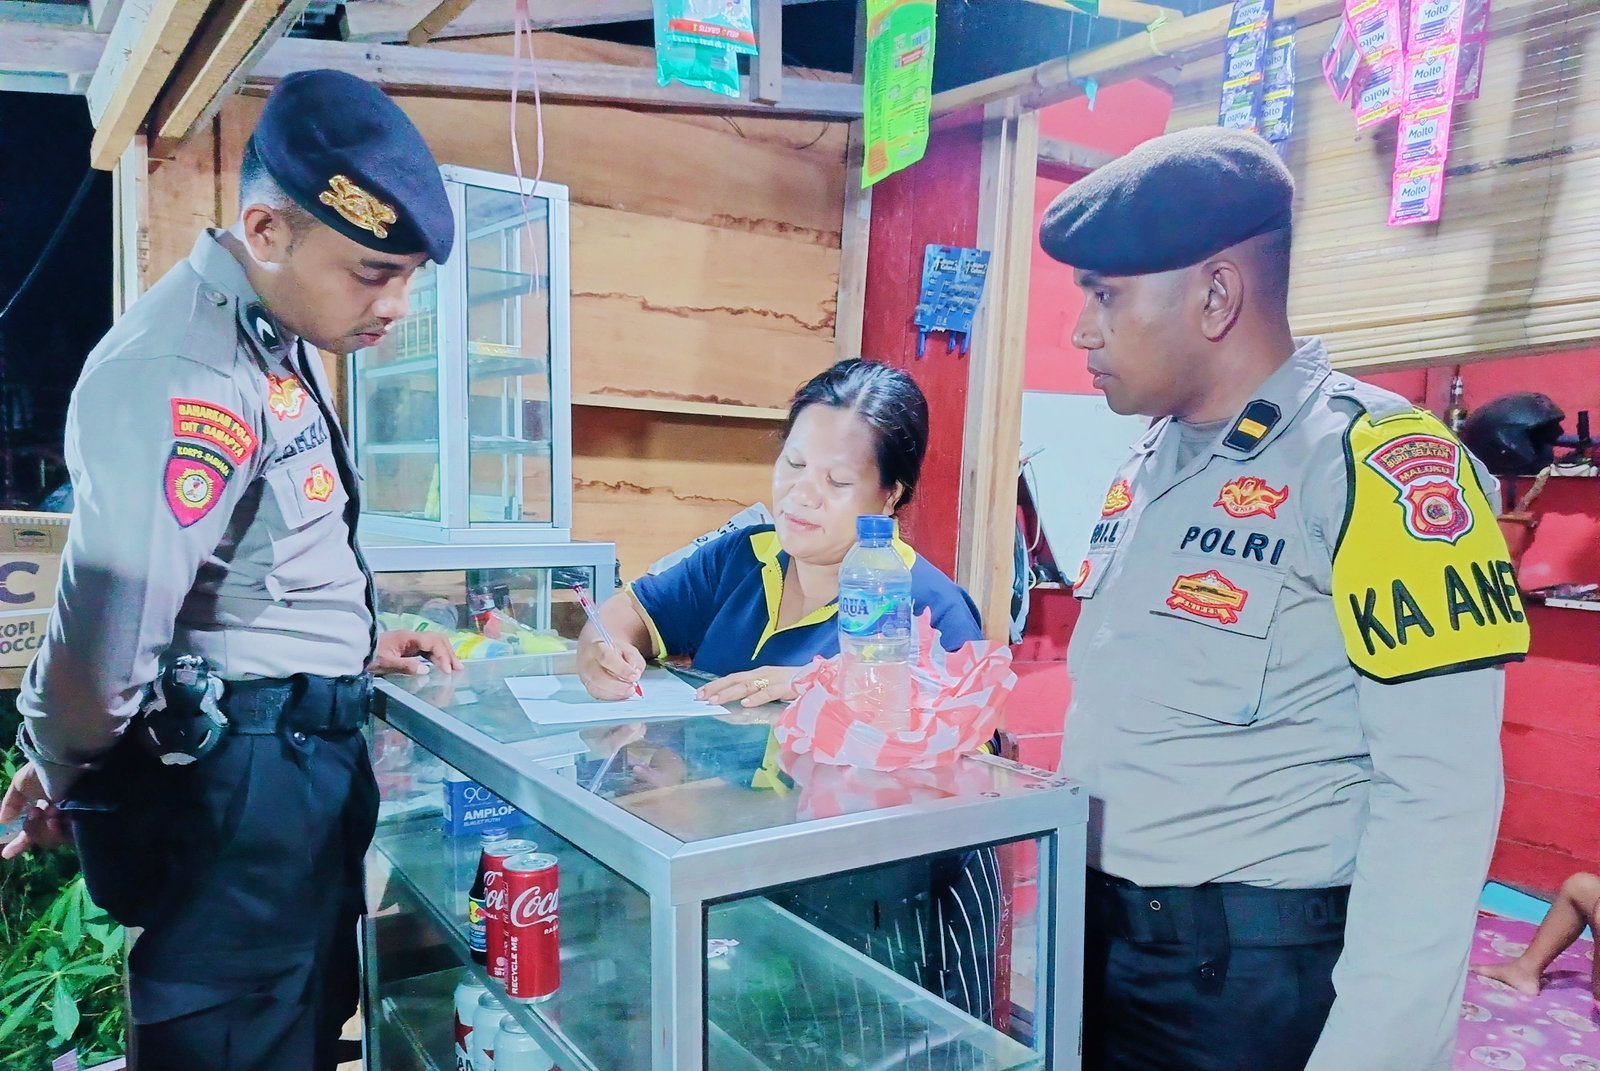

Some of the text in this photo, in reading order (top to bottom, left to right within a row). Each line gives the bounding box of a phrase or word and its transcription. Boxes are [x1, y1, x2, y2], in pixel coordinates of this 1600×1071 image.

[1360, 31, 1385, 47] Molto
[1232, 59, 1253, 70] Molto
[1414, 65, 1442, 79] Molto
[1364, 87, 1391, 103] Molto
[1227, 112, 1248, 123] Molto
[1263, 107, 1280, 118] olto
[1408, 126, 1434, 139] Molto
[1401, 184, 1427, 198] Molto
[1381, 441, 1452, 463] POLRES
[1386, 447, 1450, 469] BURU SELATAN
[1399, 465, 1450, 482] MALUKU
[1180, 526, 1286, 566] POLRI
[1349, 578, 1435, 656] KA
[0, 620, 35, 638] OPI
[511, 935, 519, 994] RECYCLE ME
